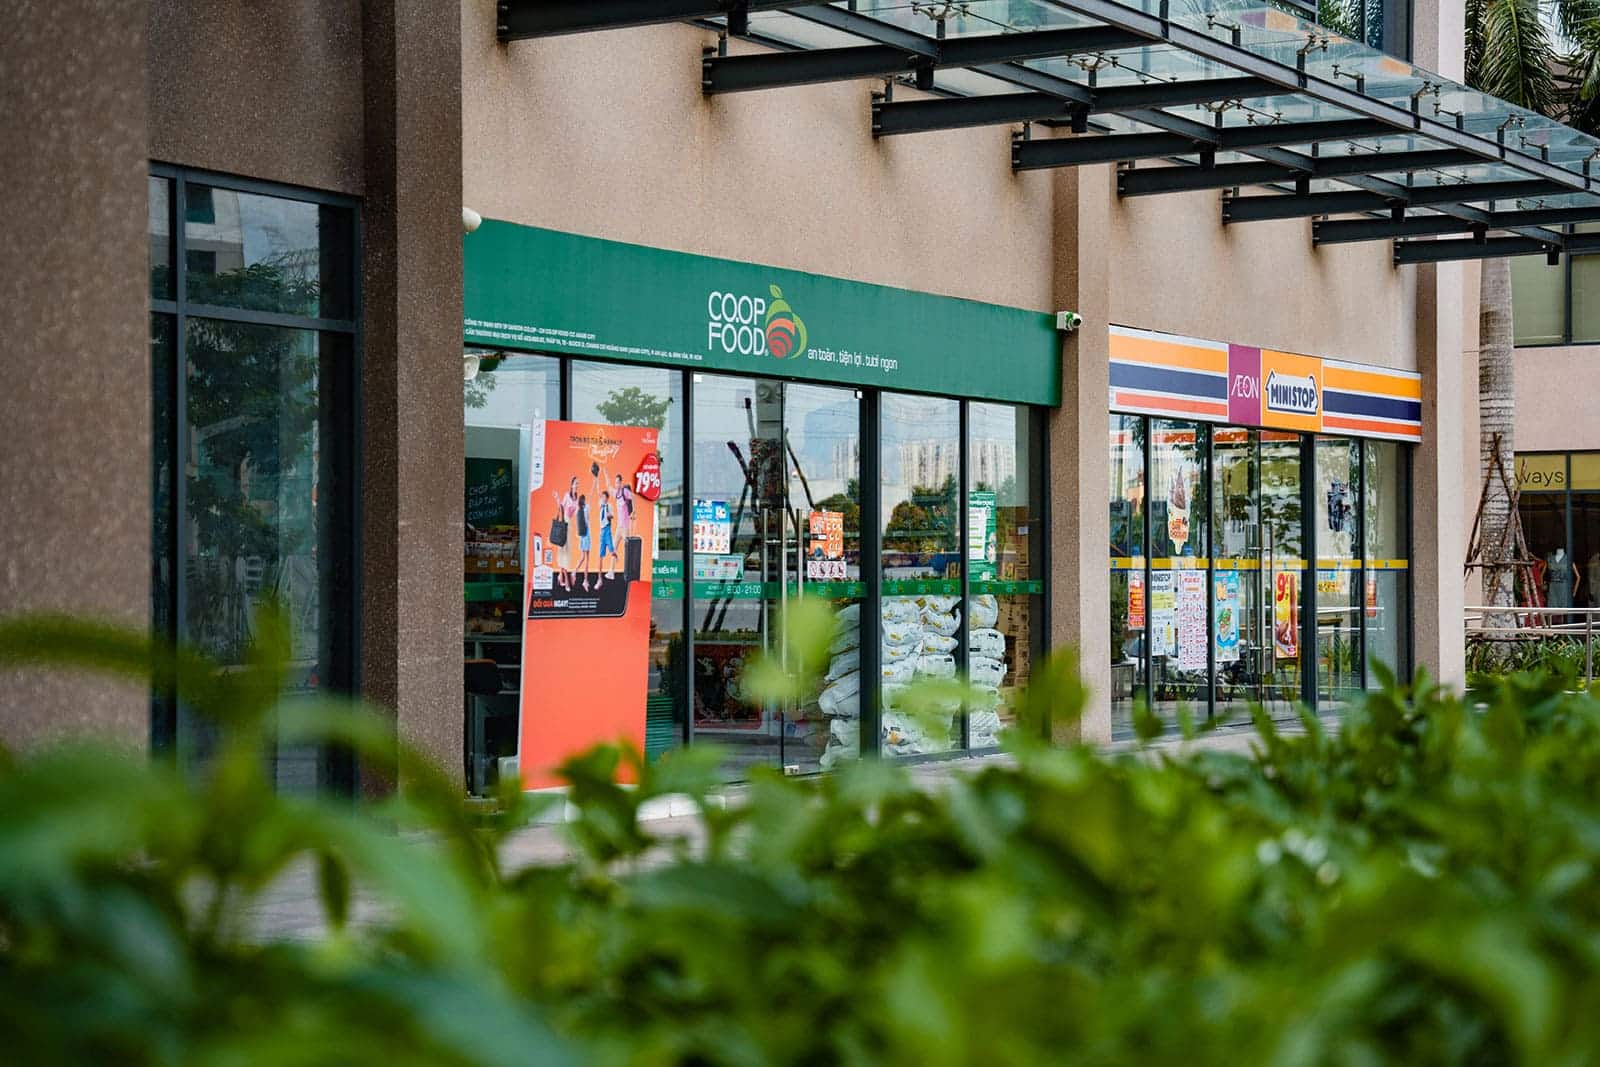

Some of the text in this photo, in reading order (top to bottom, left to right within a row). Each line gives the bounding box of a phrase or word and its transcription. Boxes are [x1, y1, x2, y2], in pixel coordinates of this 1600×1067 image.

[708, 322, 766, 356] FOOD
[808, 349, 818, 360] an
[880, 358, 897, 372] ngon
[1270, 383, 1315, 408] MINISTOP
